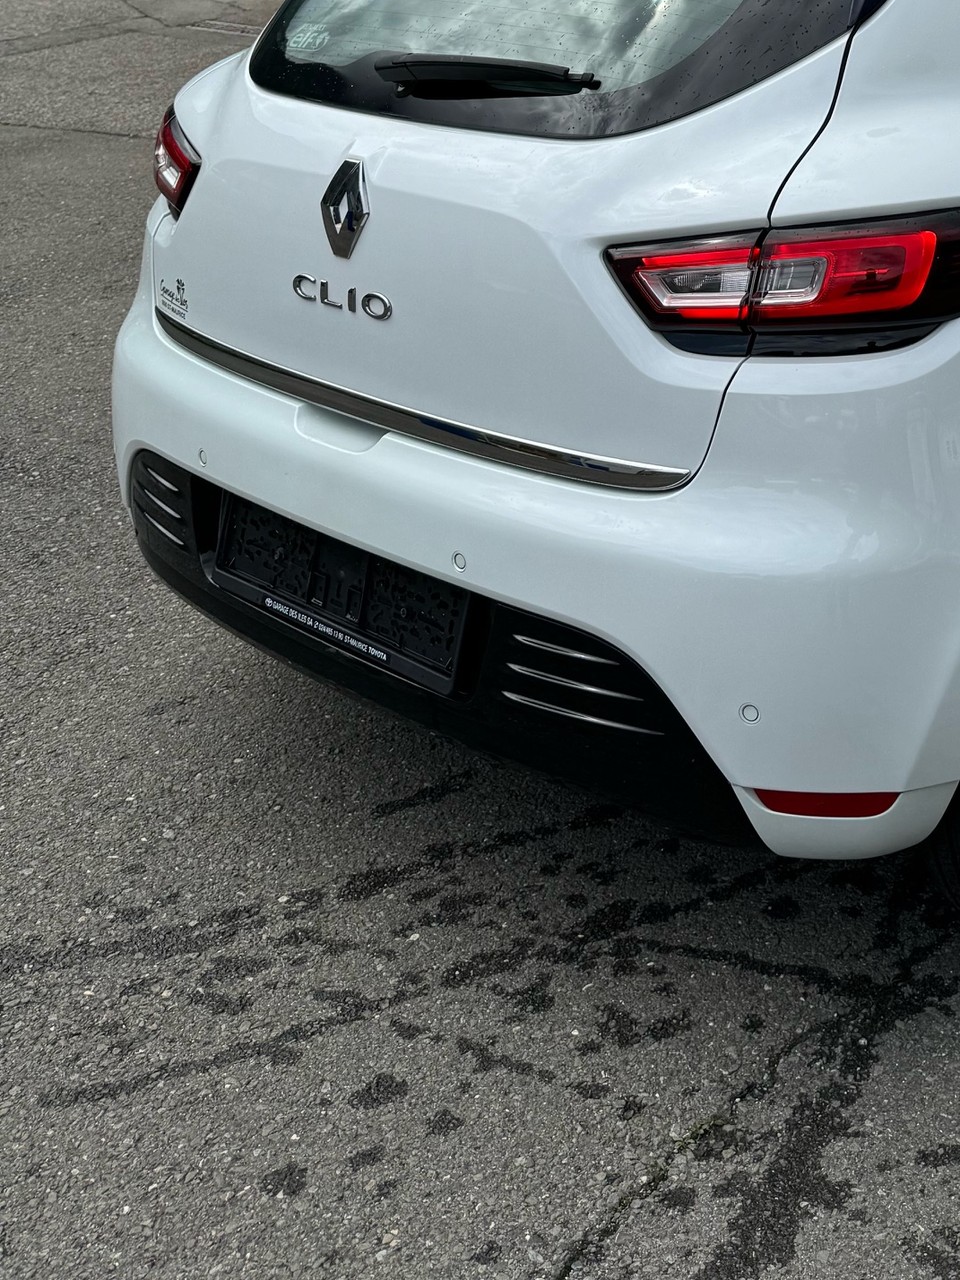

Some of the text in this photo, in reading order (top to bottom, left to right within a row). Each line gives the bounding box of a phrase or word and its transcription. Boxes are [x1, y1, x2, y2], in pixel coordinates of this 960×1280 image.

[292, 272, 393, 321] CLIO
[272, 600, 290, 615] GARAGE
[368, 646, 387, 661] TOYOTA
